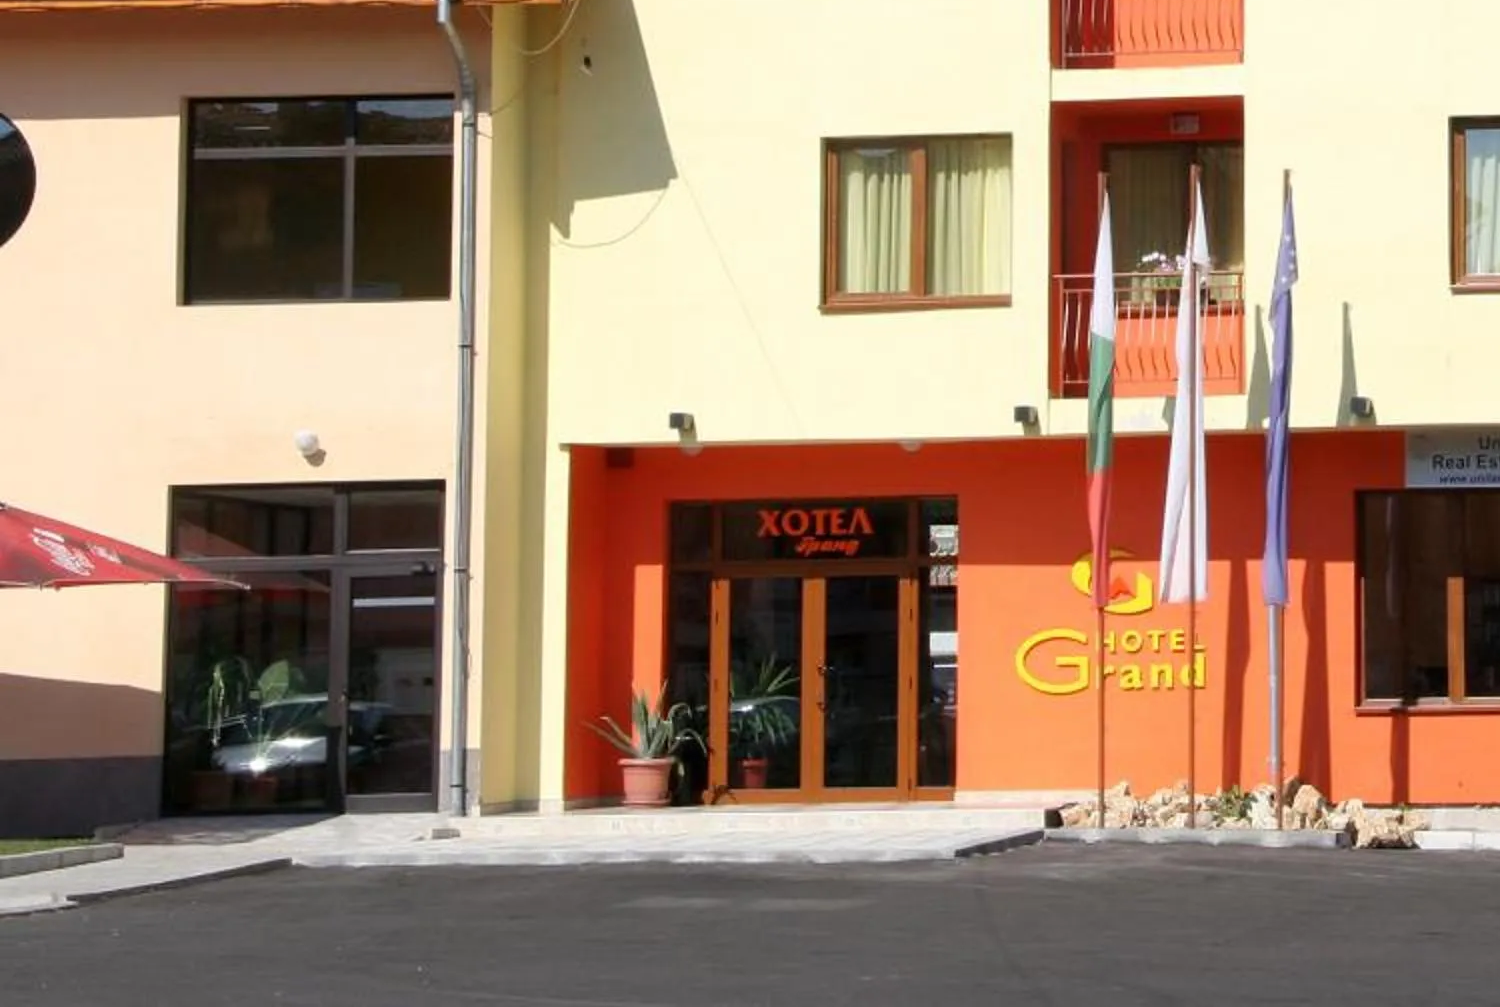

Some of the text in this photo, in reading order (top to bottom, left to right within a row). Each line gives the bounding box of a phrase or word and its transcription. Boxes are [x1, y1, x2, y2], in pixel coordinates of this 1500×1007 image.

[1431, 454, 1471, 470] Real
[757, 507, 875, 538] ХОТЕЛ
[1095, 628, 1208, 654] HOTEL
[1014, 627, 1208, 696] Grand
